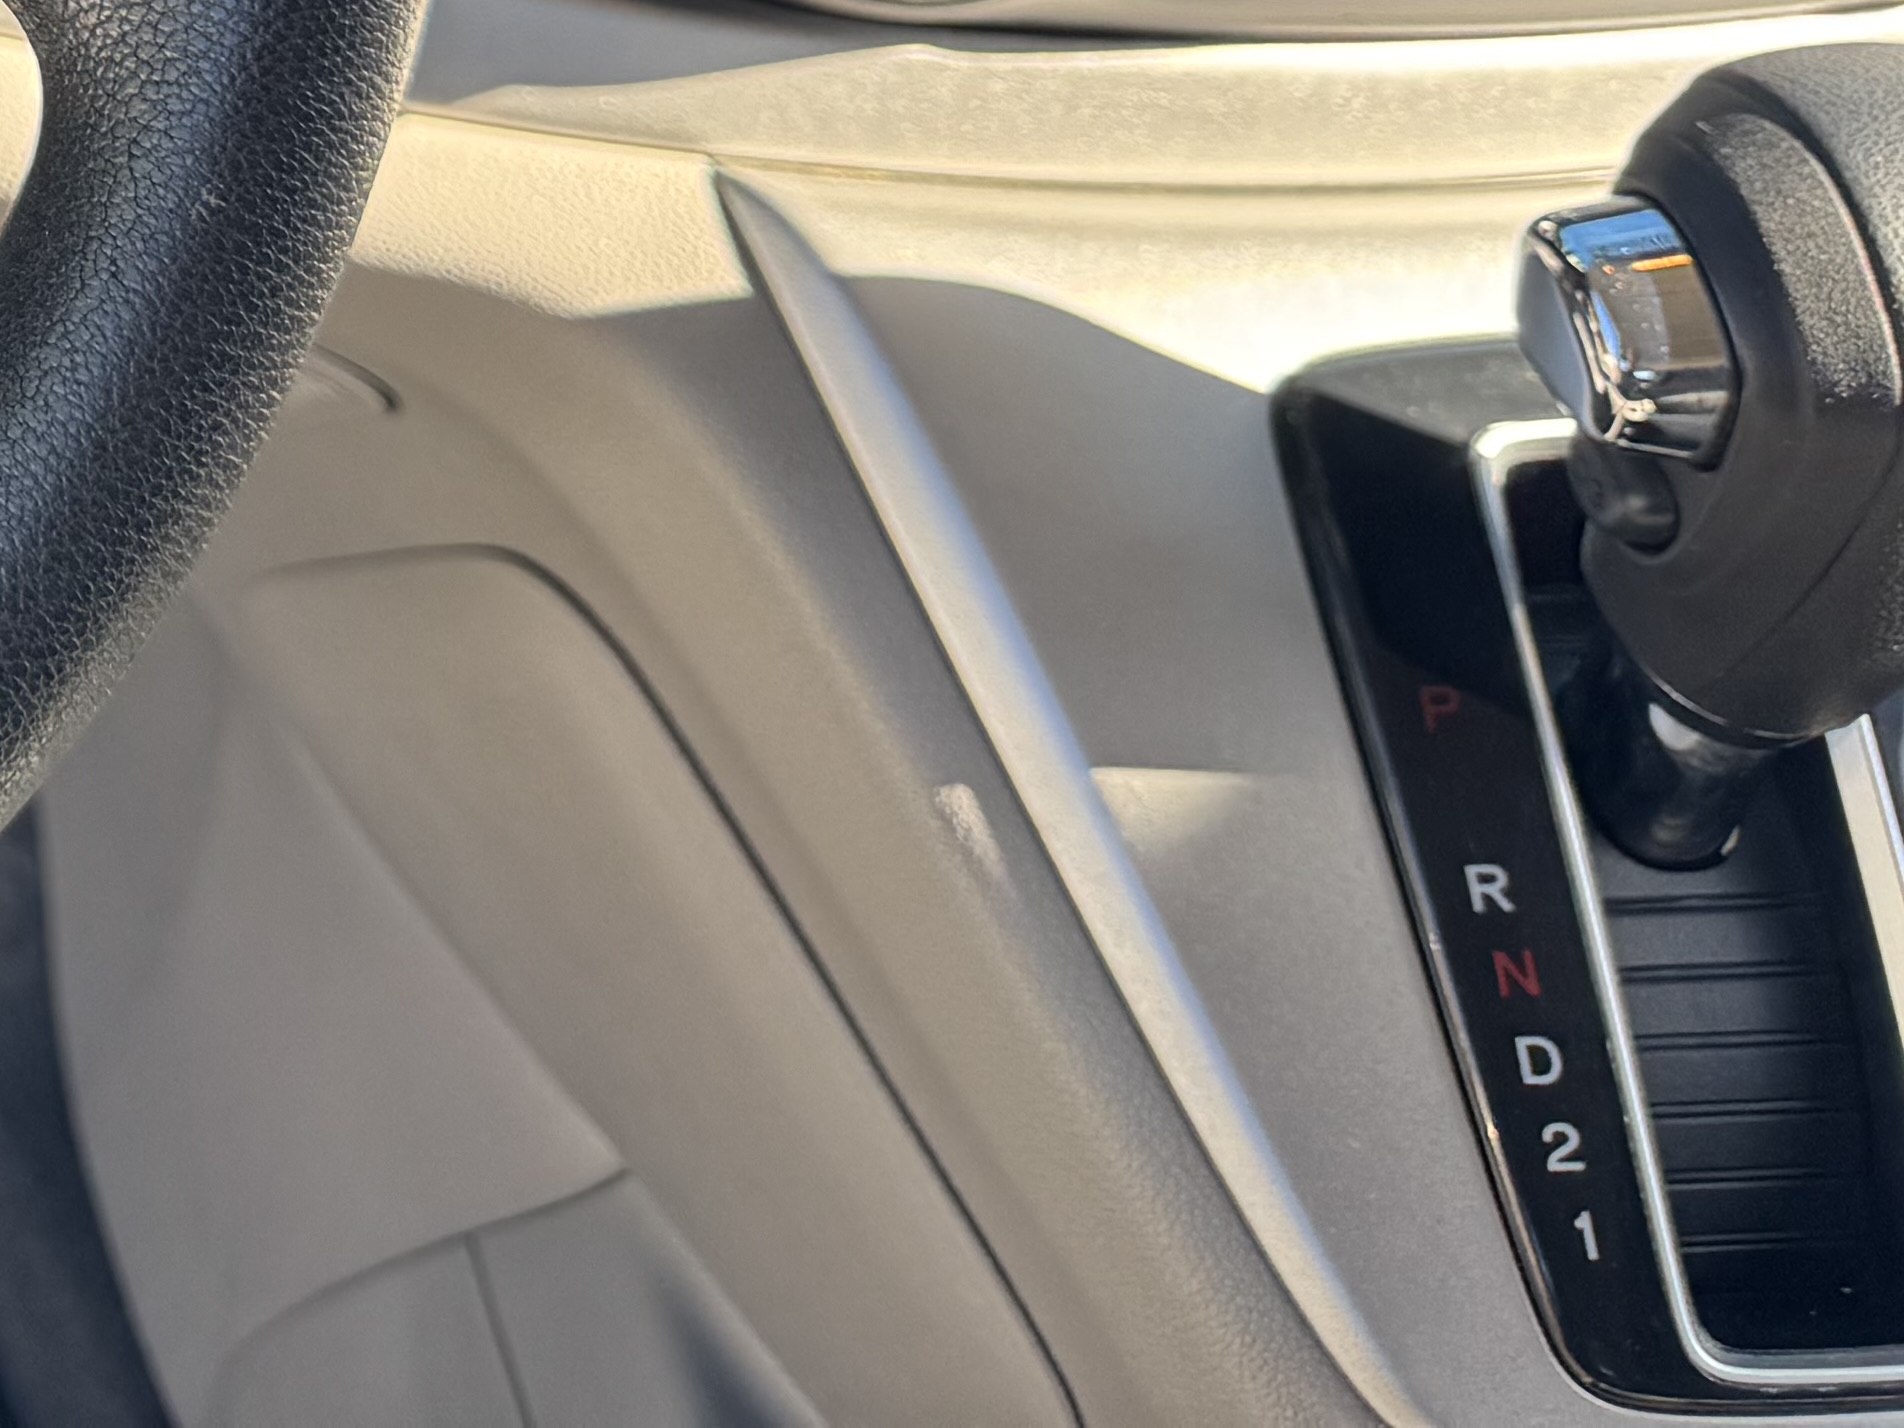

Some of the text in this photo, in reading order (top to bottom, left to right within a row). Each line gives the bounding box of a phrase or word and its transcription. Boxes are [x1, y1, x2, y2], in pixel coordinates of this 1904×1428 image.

[1420, 685, 1463, 732] P
[1463, 863, 1516, 914] R
[1493, 949, 1542, 998] N
[1515, 1036, 1563, 1085] D
[1542, 1122, 1587, 1172] 2
[1574, 1210, 1600, 1261] 1
